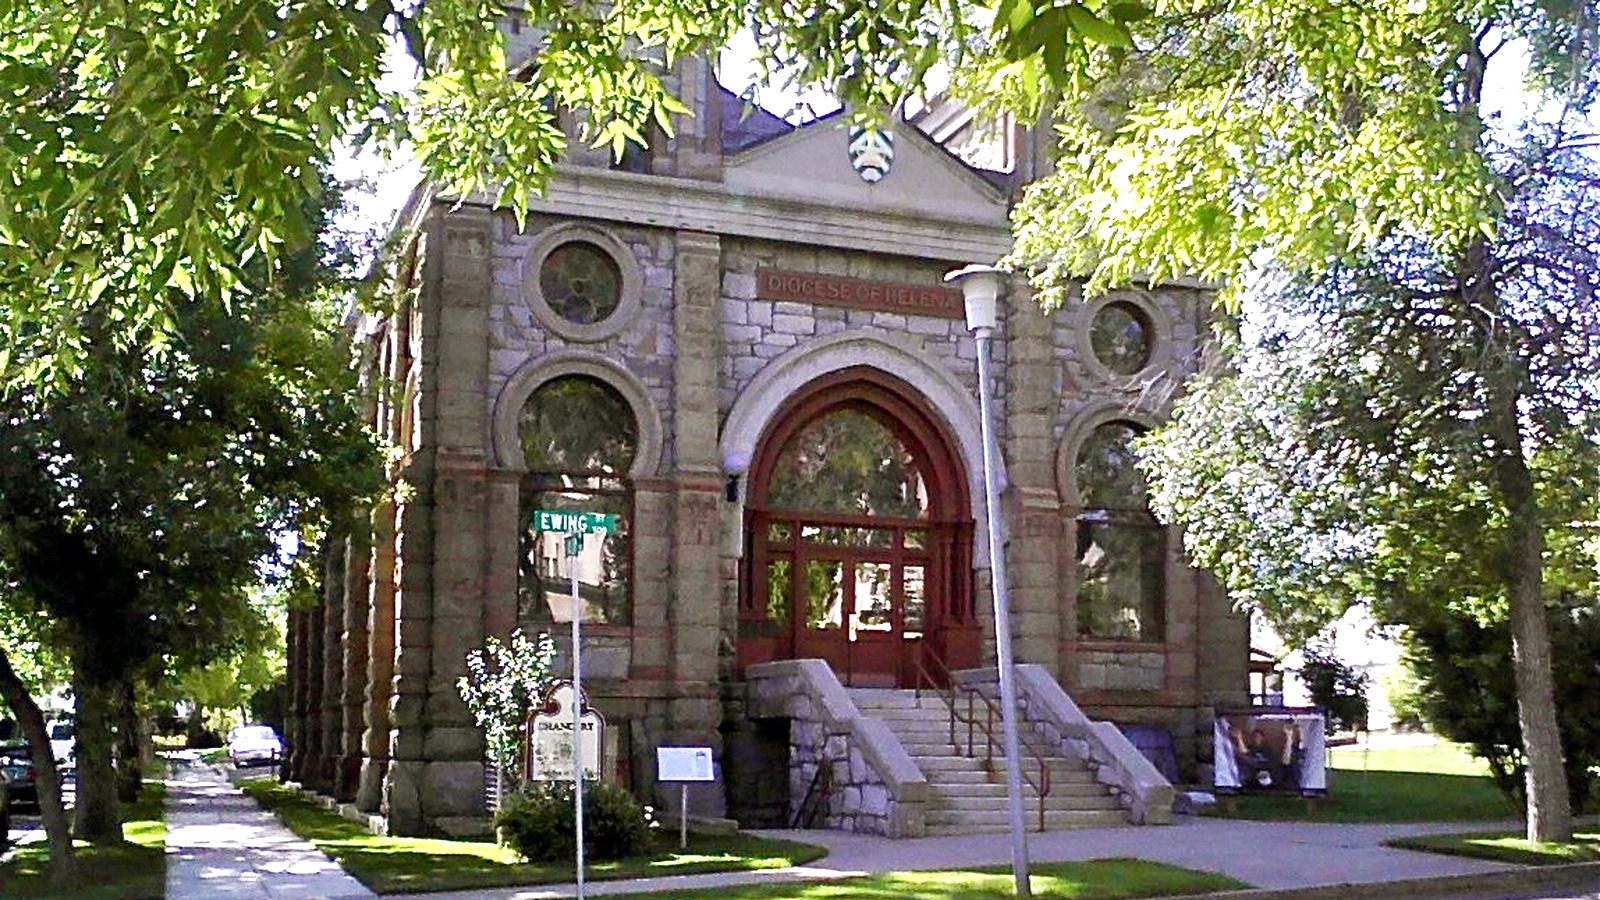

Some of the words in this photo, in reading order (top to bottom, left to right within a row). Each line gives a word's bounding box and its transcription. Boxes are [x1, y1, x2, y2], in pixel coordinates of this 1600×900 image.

[768, 275, 851, 300] DIOCESE
[855, 281, 881, 301] OF
[885, 287, 957, 309] HELENA
[541, 513, 587, 532] EWING
